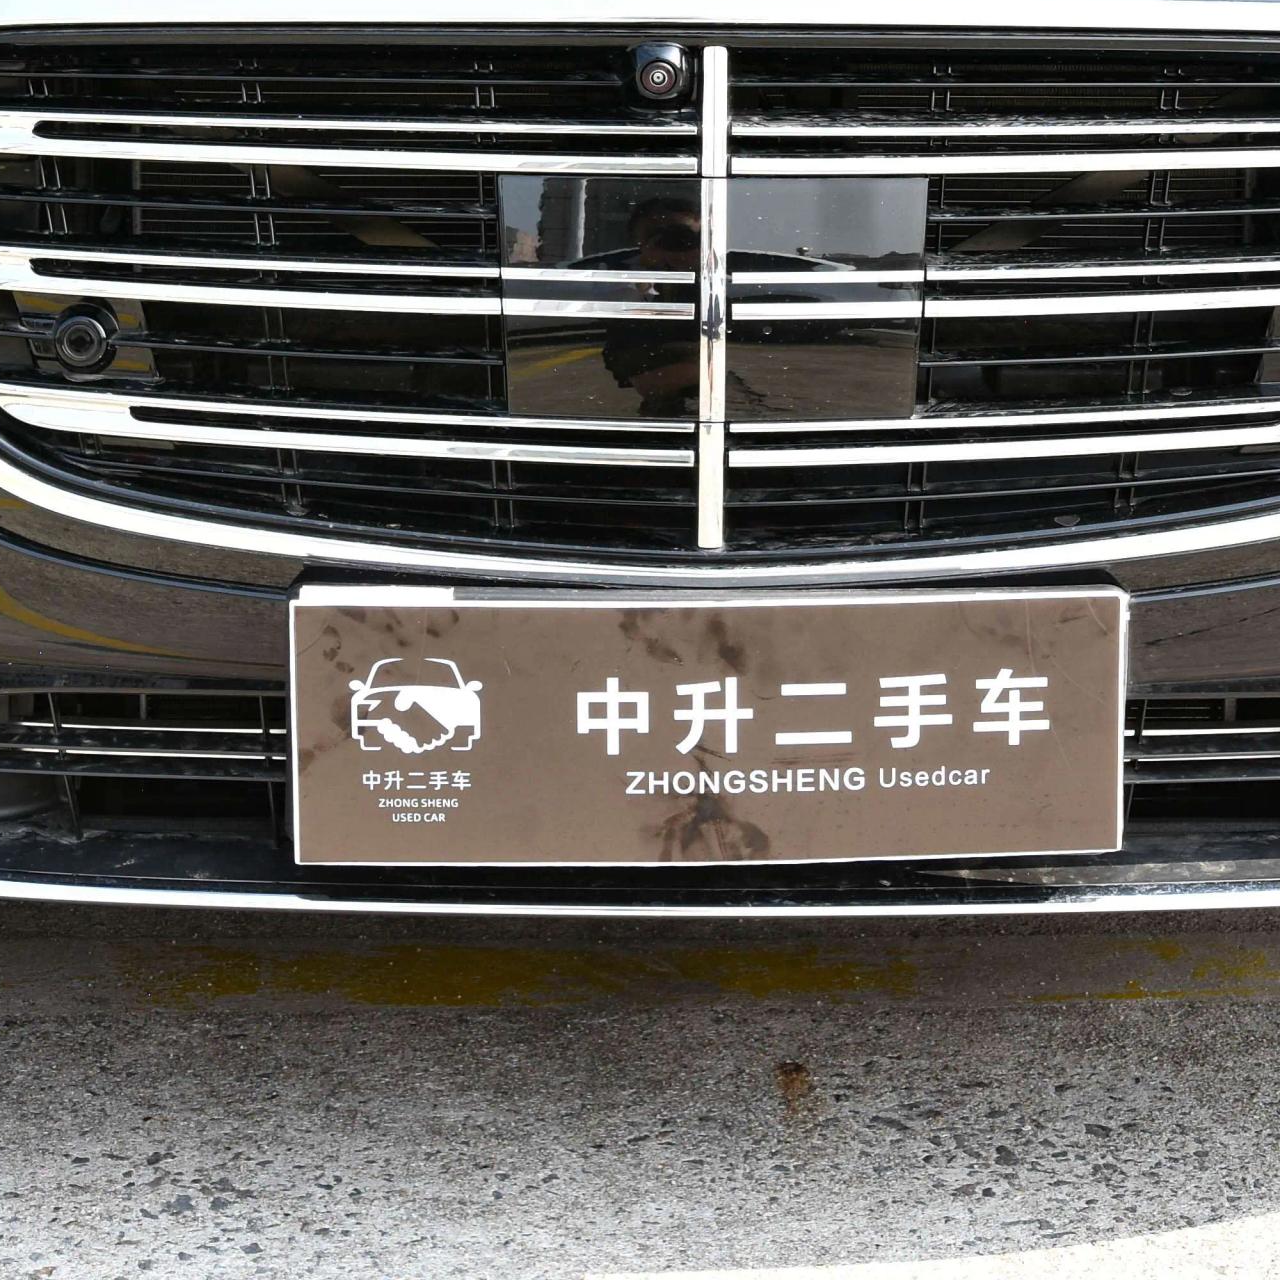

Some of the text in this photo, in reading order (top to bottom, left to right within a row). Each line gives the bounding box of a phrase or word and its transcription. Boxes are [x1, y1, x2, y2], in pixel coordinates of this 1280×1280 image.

[575, 667, 1051, 756] 中升二手车
[362, 770, 472, 791] 中升二手车
[625, 764, 991, 795] ZHONGSHENG Usedcar
[378, 798, 459, 808] ZHONG SHENG
[392, 813, 446, 823] USED CAR
